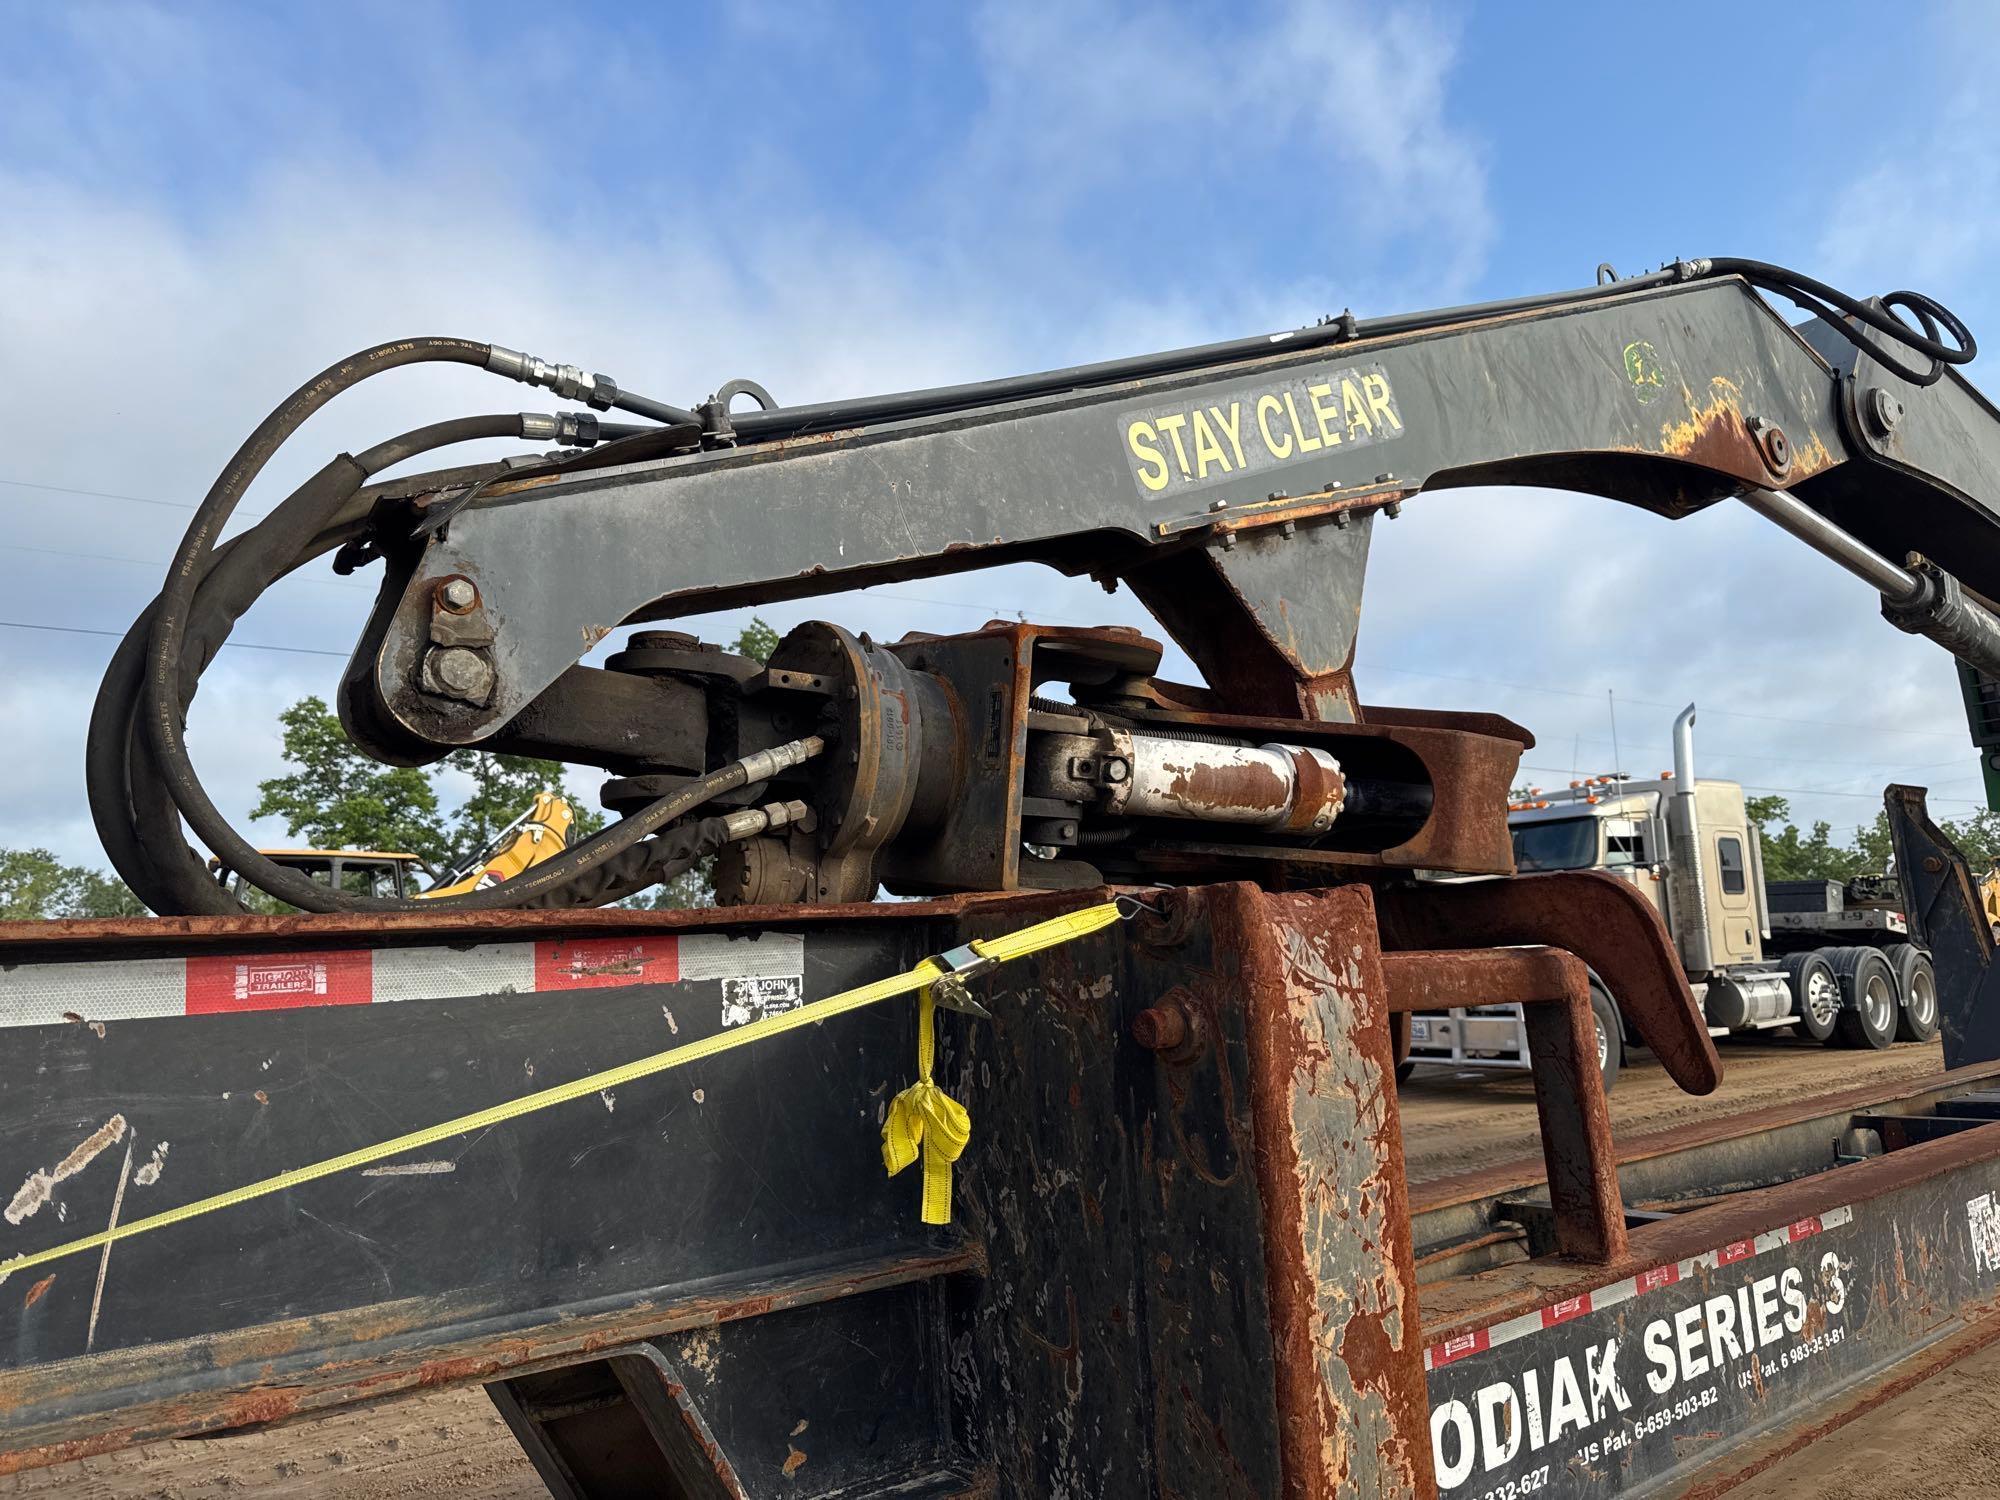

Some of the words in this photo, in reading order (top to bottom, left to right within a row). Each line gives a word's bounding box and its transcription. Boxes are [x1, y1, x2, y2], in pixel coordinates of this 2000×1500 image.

[1128, 402, 1247, 491] STAY
[1256, 373, 1402, 459] CLEAR
[524, 867, 567, 890] TECHNOLOGY
[256, 981, 308, 991] TRAILERS
[759, 979, 788, 991] JOHN
[1644, 1266, 1808, 1395] SERIES
[1820, 1251, 1846, 1315] 3
[1603, 1428, 1632, 1456] Pat.
[1634, 1385, 1719, 1440] 6-659-503-B2
